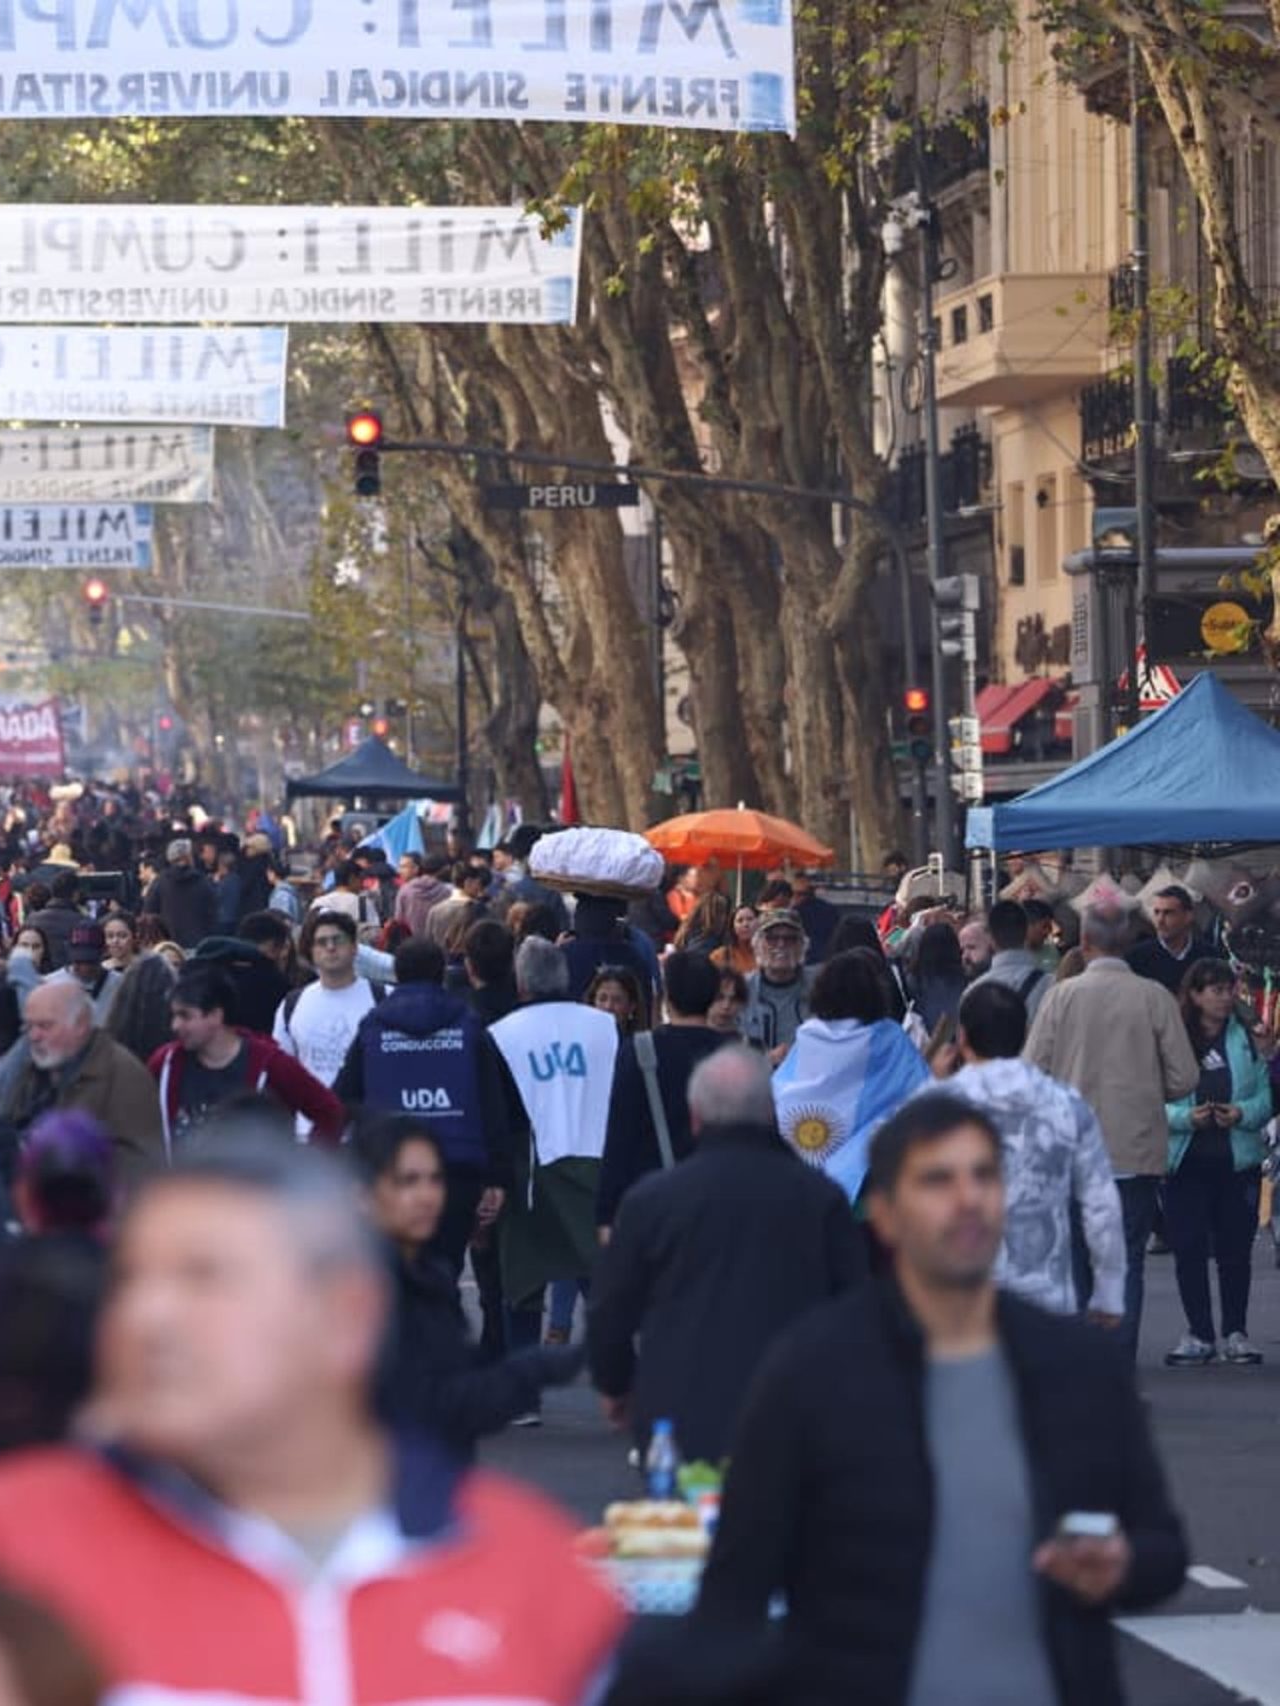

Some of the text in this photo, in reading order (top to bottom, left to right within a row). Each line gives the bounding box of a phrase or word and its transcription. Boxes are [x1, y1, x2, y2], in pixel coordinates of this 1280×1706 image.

[529, 485, 595, 507] PERU
[381, 1036, 463, 1052] CONDUCCIÓN
[401, 1087, 452, 1110] UDA
